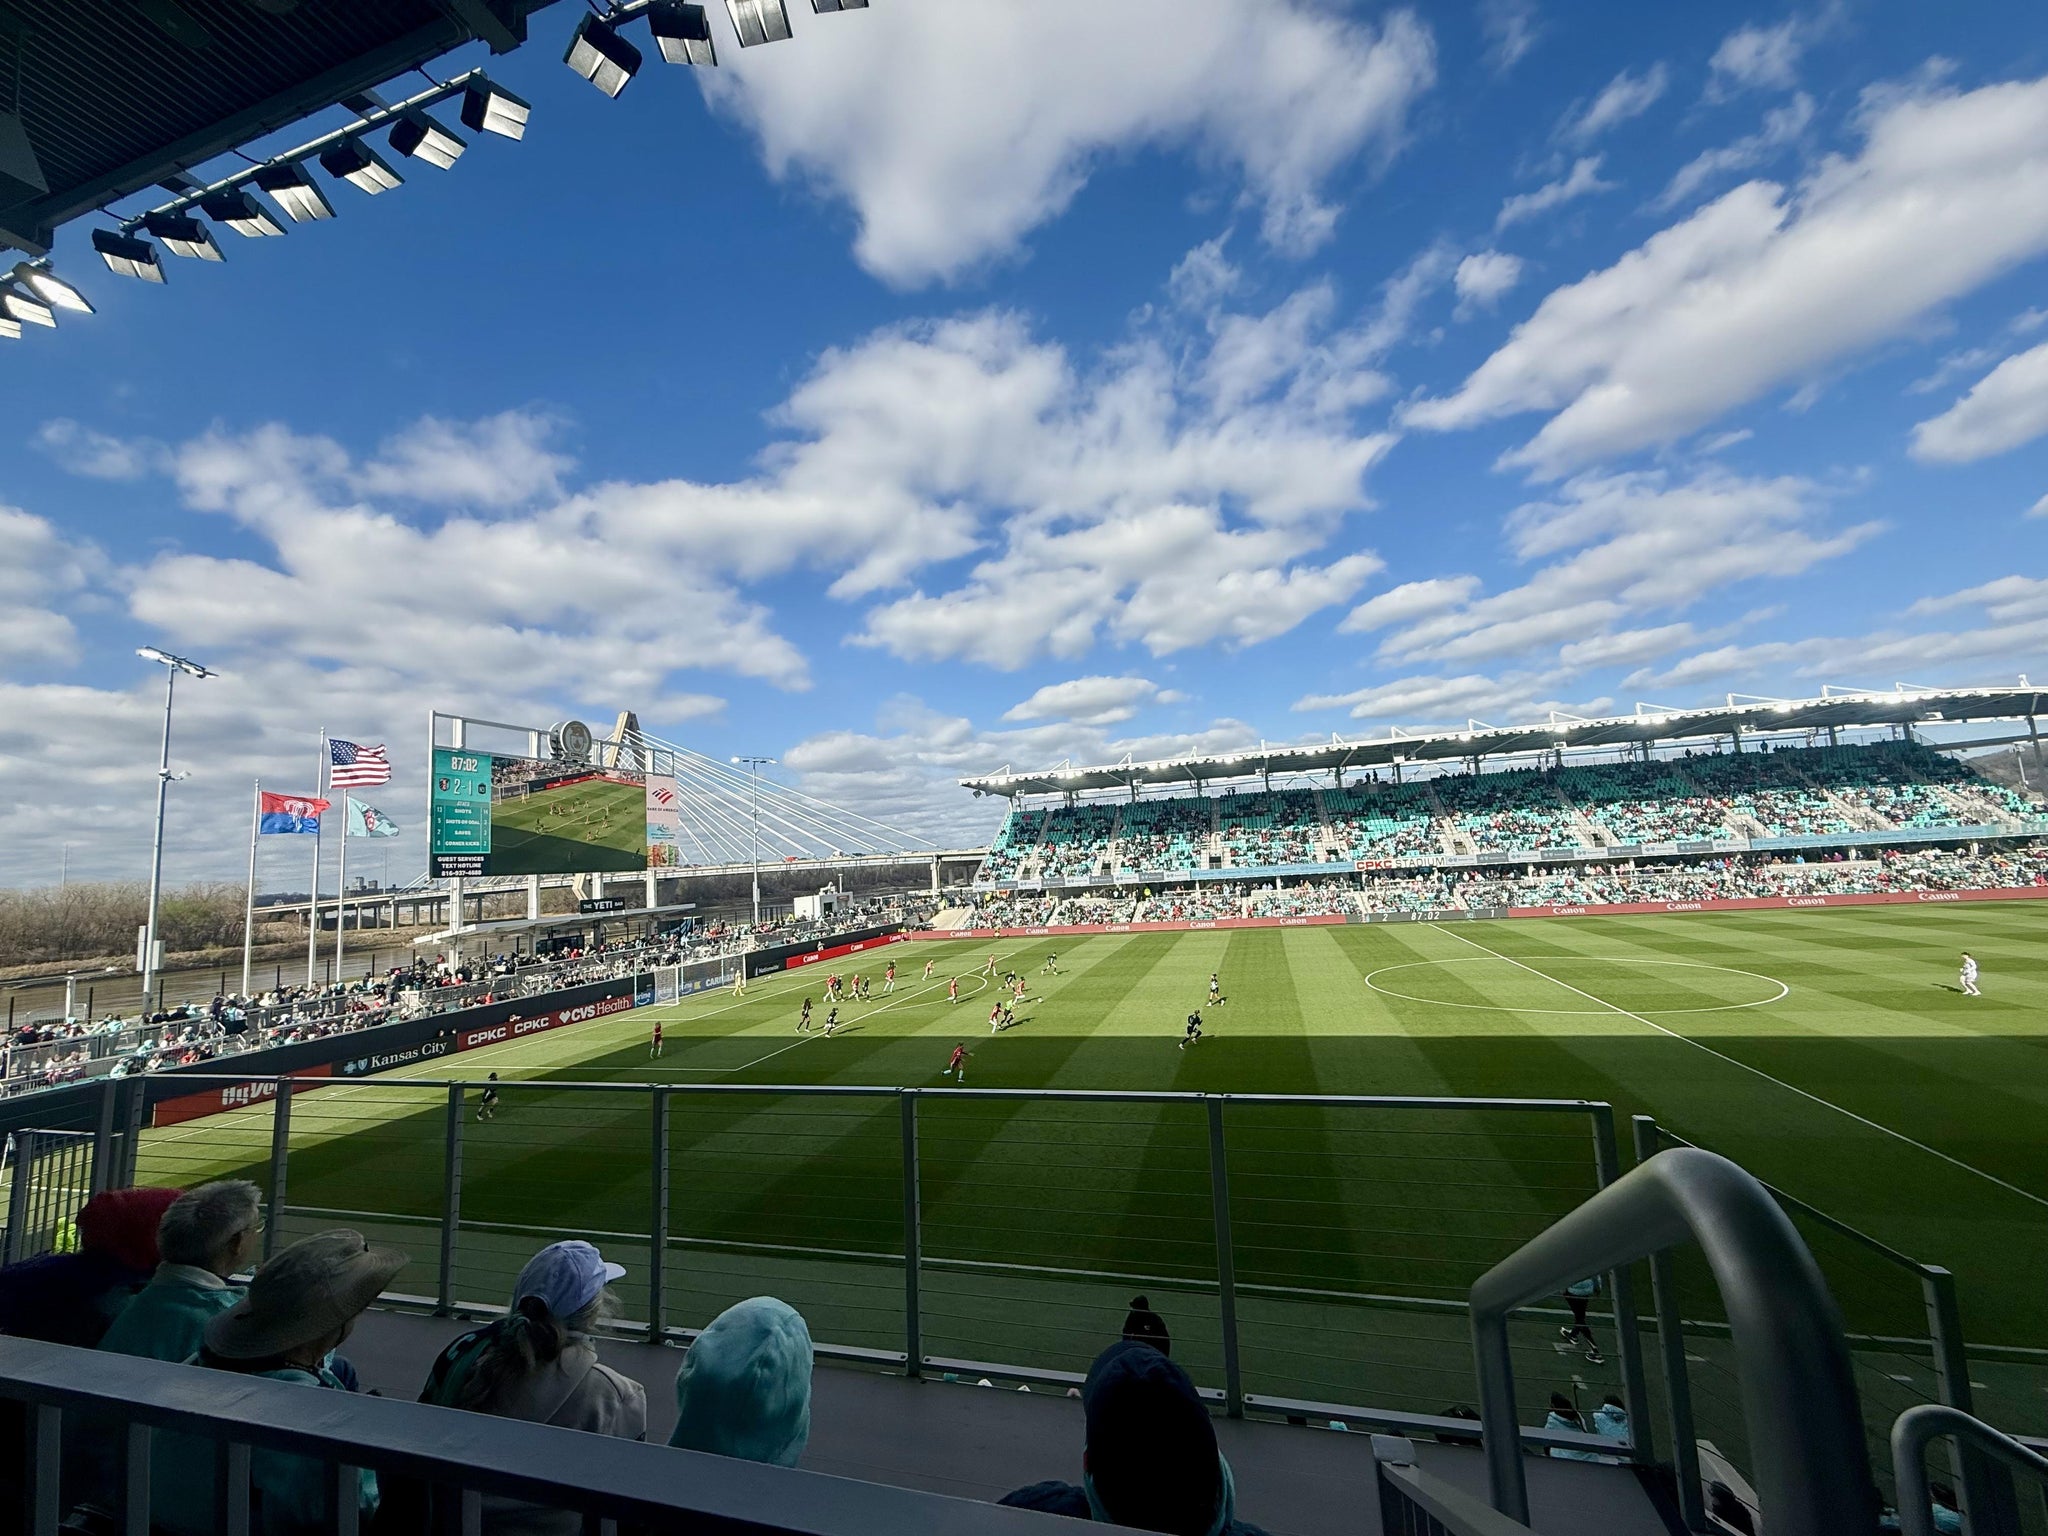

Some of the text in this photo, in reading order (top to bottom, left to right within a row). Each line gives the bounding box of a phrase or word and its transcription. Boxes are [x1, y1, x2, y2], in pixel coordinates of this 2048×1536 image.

[451, 756, 478, 772] 87:02
[1356, 857, 1445, 870] CPKC STADIUM
[1787, 897, 1826, 906] Canon
[1918, 891, 1960, 902] Canon
[593, 900, 613, 910] YETI
[1666, 901, 1702, 910] Canon
[1552, 906, 1586, 915] Canon
[1279, 917, 1307, 925] Canon
[1382, 913, 1388, 922] 2
[1410, 911, 1440, 920] 87:02
[1105, 924, 1130, 932] Canon
[1190, 920, 1216, 928] Canon
[850, 943, 864, 951] Canon
[803, 954, 819, 963] Canon
[571, 997, 630, 1022] CVS Health
[514, 1016, 550, 1034] CPKC
[467, 1027, 507, 1046] CPKC
[370, 1042, 448, 1069] Kansas City
